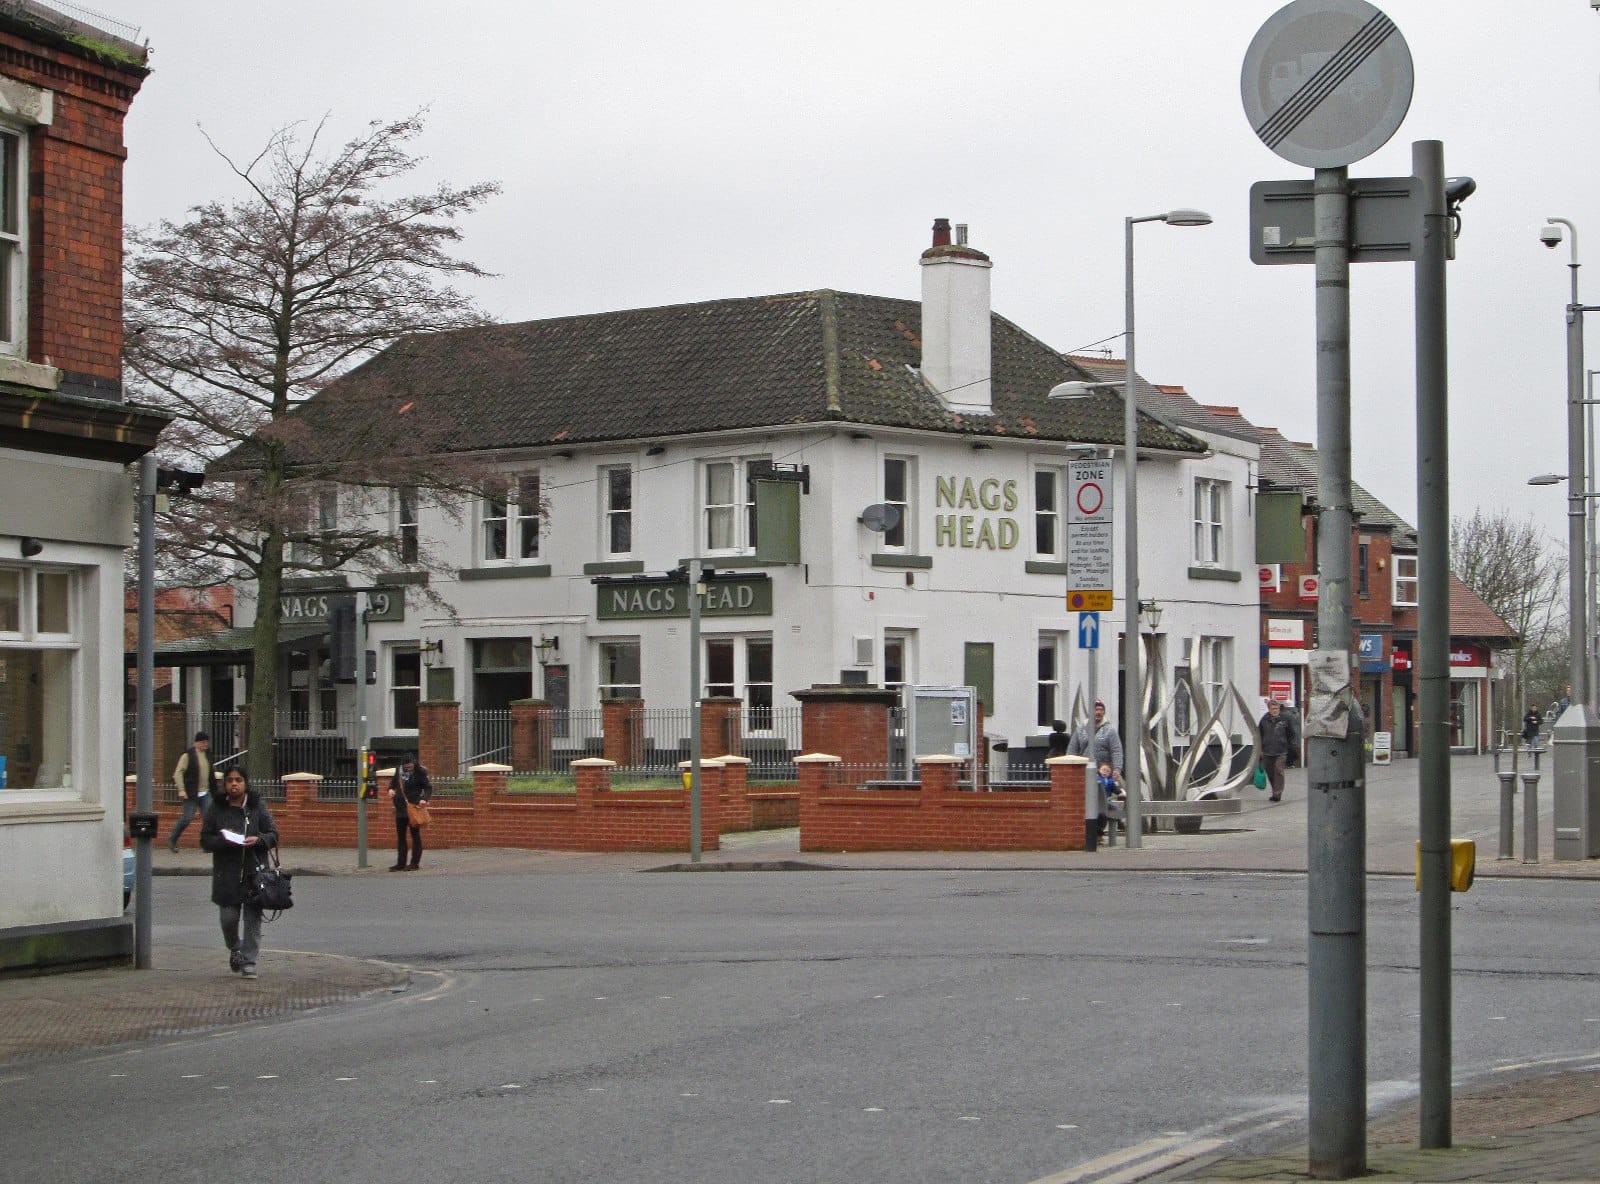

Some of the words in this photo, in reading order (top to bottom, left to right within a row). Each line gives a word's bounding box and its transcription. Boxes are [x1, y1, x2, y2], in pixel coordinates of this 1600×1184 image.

[1070, 461, 1110, 469] PEDESTRIAN
[1075, 470, 1104, 481] ZONE
[936, 475, 1018, 512] NAGS
[936, 514, 1019, 550] HEAD
[281, 595, 329, 617] NAGS
[613, 588, 675, 612] NAGS
